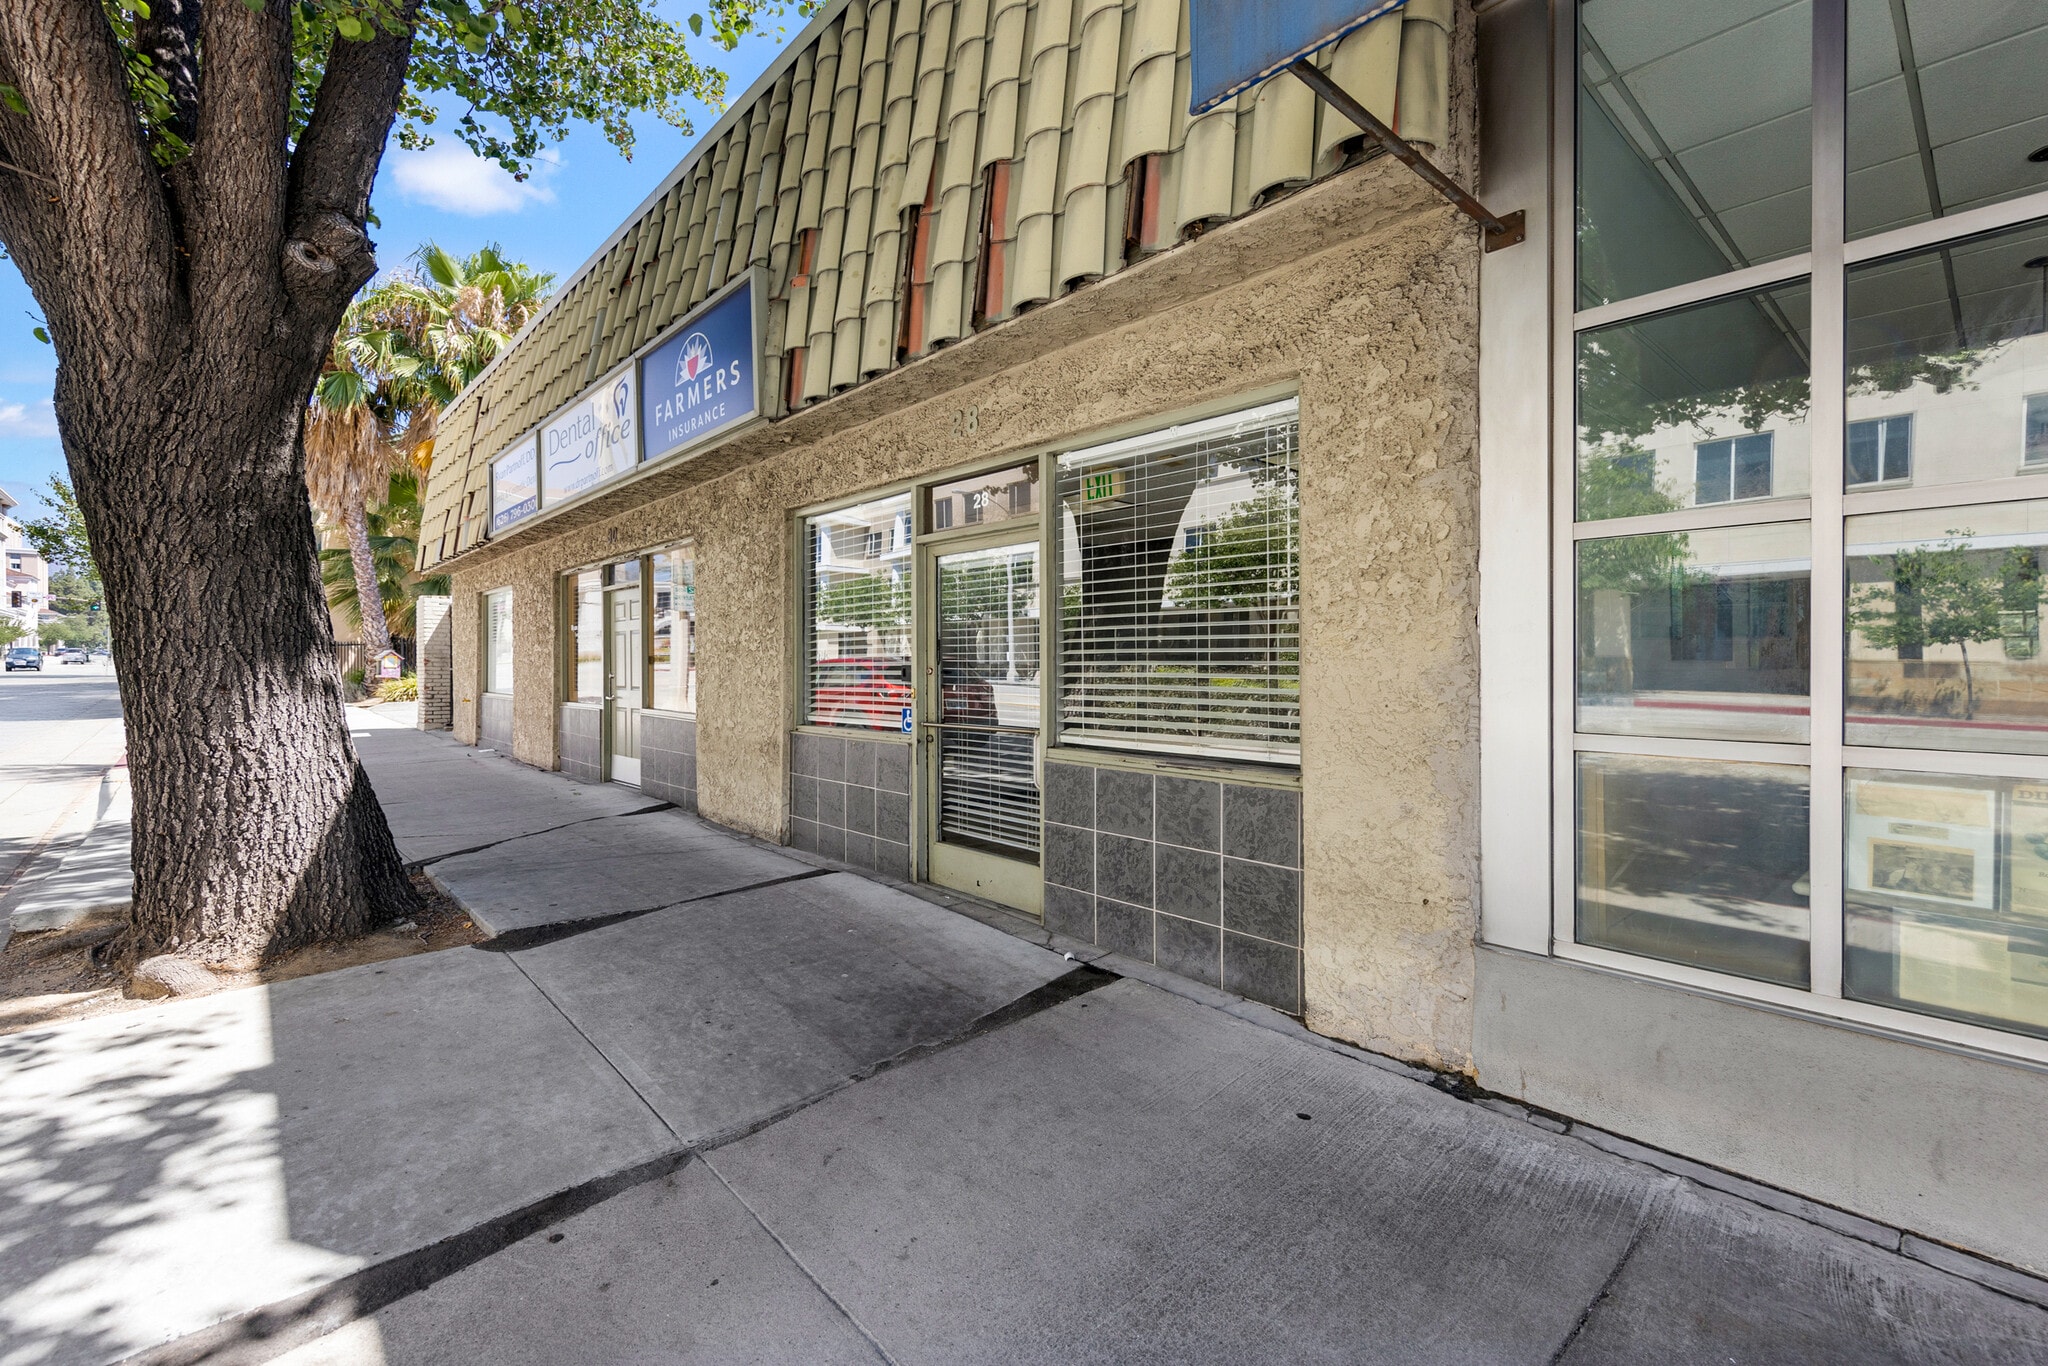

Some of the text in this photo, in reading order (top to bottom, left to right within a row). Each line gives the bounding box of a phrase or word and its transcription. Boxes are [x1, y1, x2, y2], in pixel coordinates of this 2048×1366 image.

[655, 359, 740, 427] FARMERS
[549, 402, 595, 456] Dental
[668, 402, 726, 442] INSURANCE
[949, 404, 980, 439] 28
[526, 447, 536, 463] DD
[585, 419, 630, 462] office
[973, 492, 989, 509] 28
[1086, 473, 1113, 500] EXIT
[510, 499, 536, 521] 796-030
